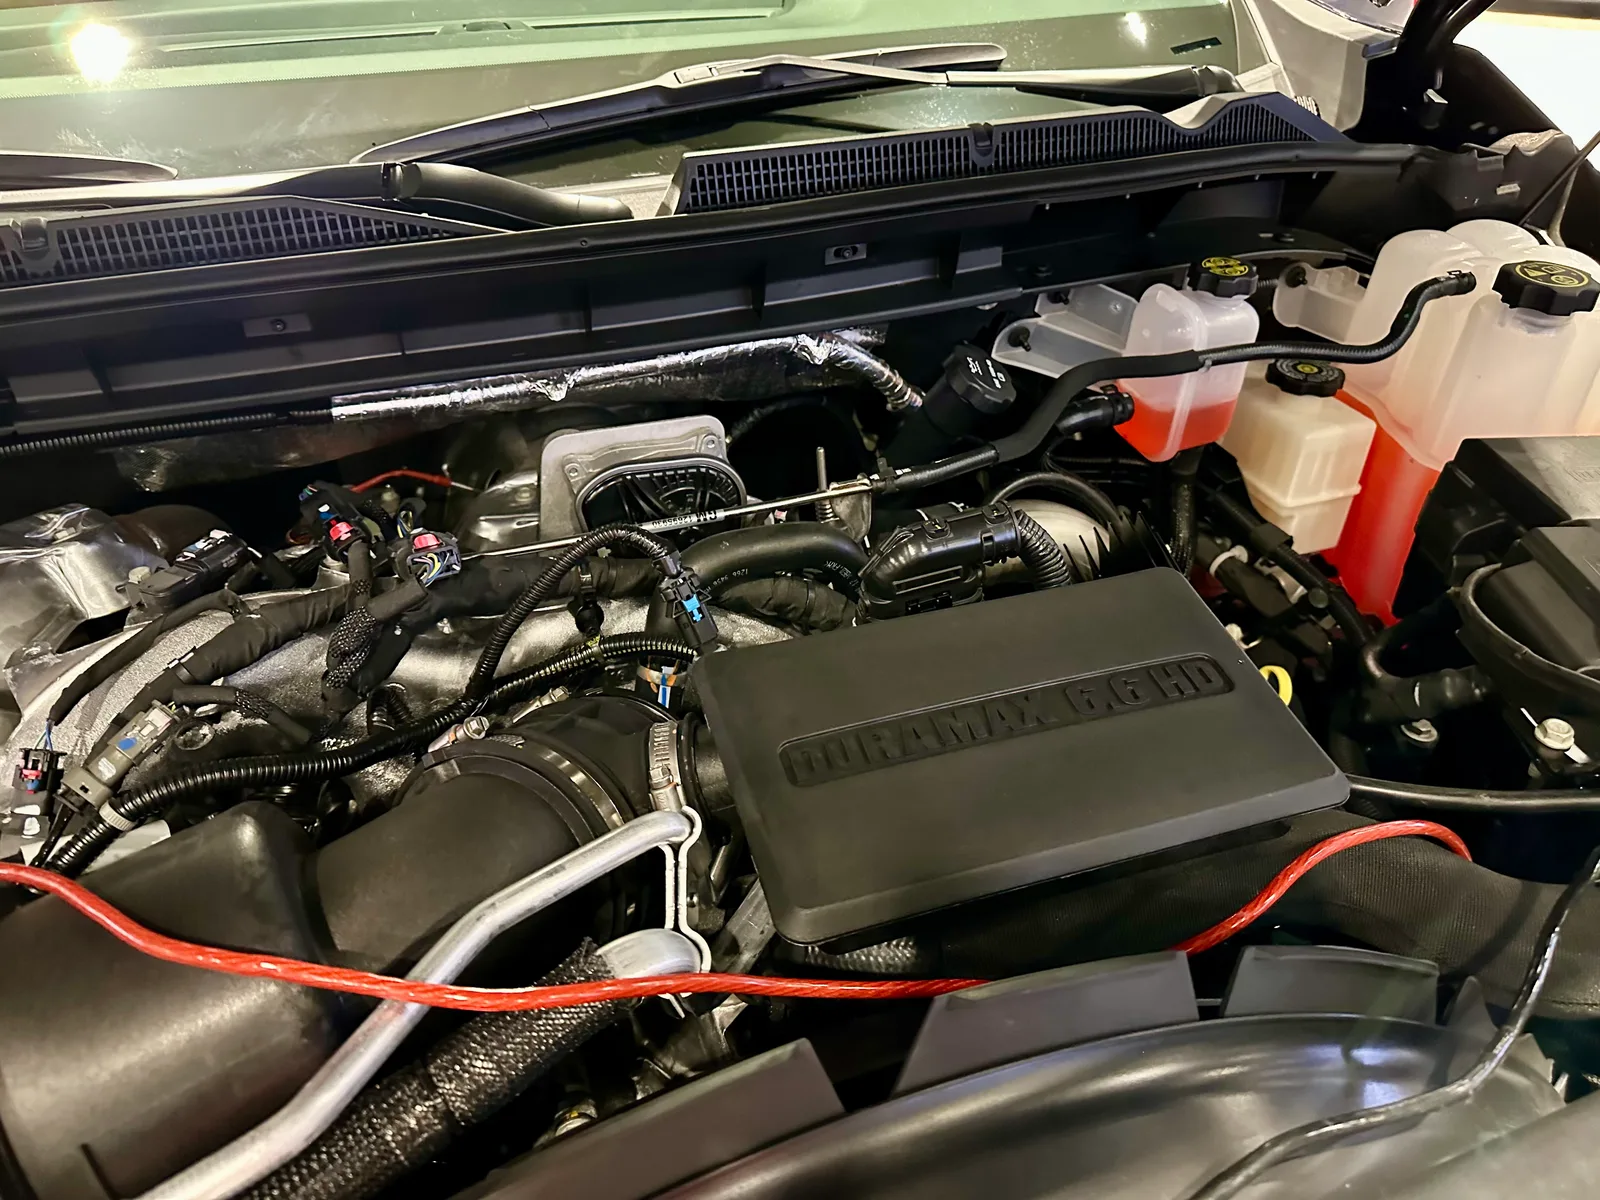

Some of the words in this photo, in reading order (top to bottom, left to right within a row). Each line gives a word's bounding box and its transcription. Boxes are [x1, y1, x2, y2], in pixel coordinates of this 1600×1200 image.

[695, 509, 717, 522] GM
[789, 690, 1058, 781] DURAMAX
[1064, 671, 1151, 715] 6.6
[1148, 658, 1225, 699] HD
